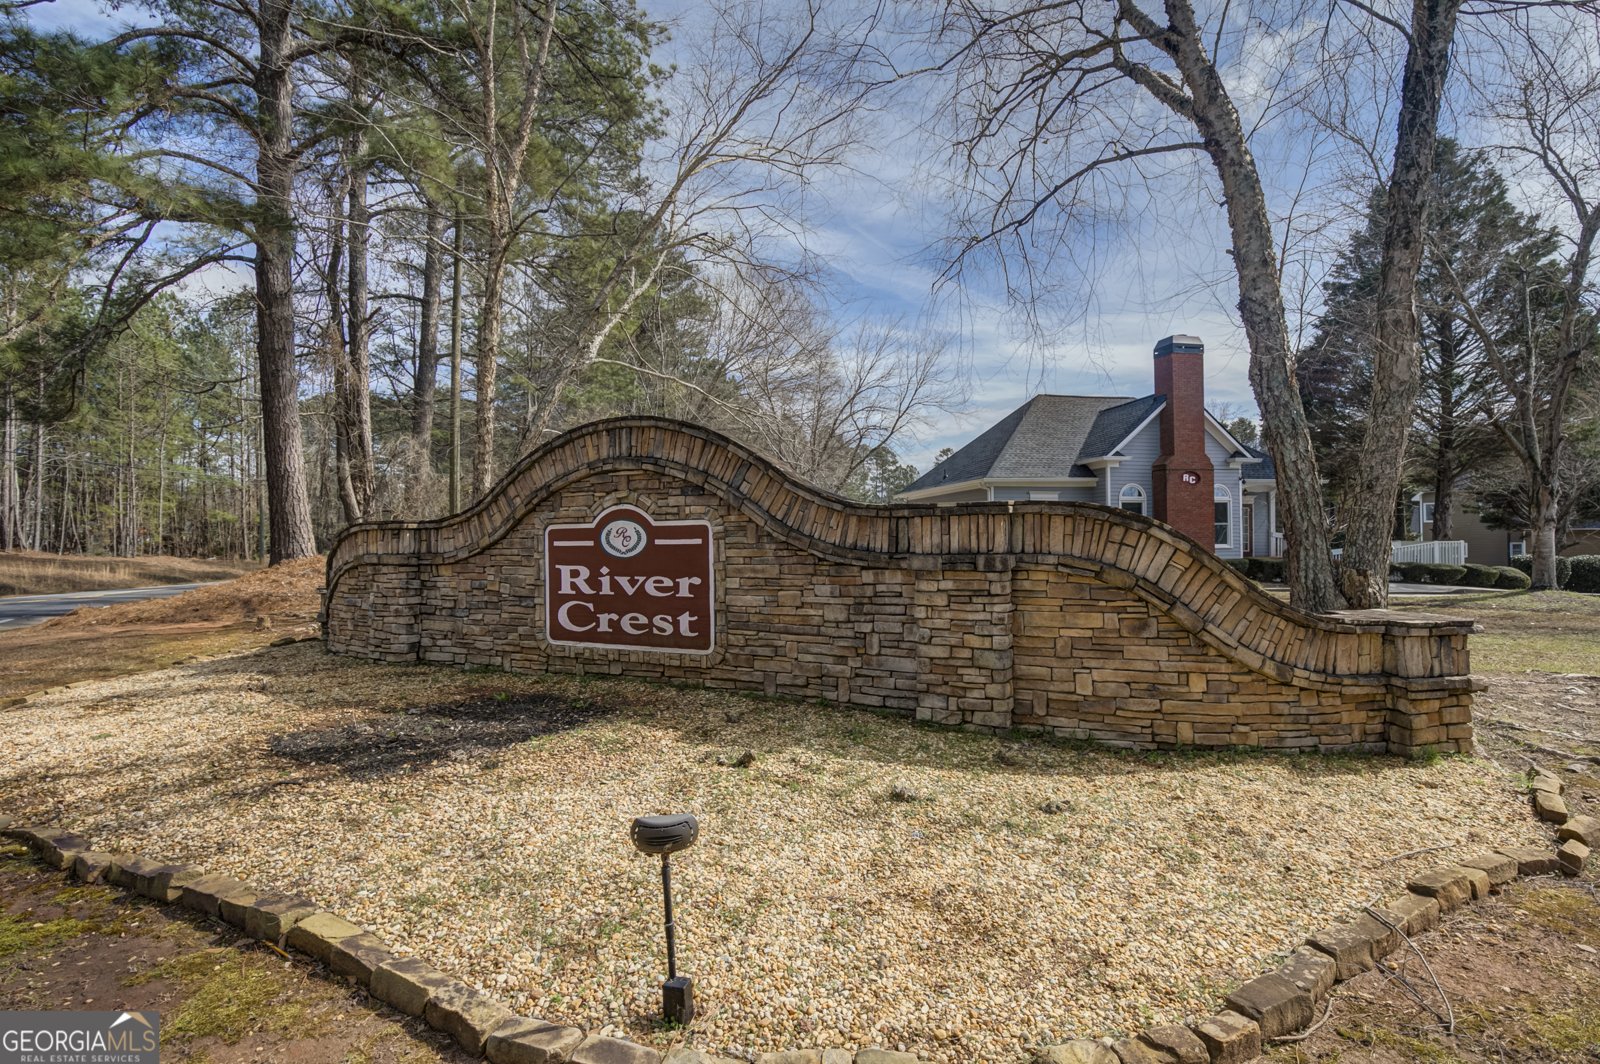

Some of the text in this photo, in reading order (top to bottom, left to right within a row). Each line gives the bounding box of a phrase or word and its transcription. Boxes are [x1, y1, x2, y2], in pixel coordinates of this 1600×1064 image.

[613, 526, 632, 548] RC
[555, 564, 702, 598] River
[557, 600, 699, 637] Crest
